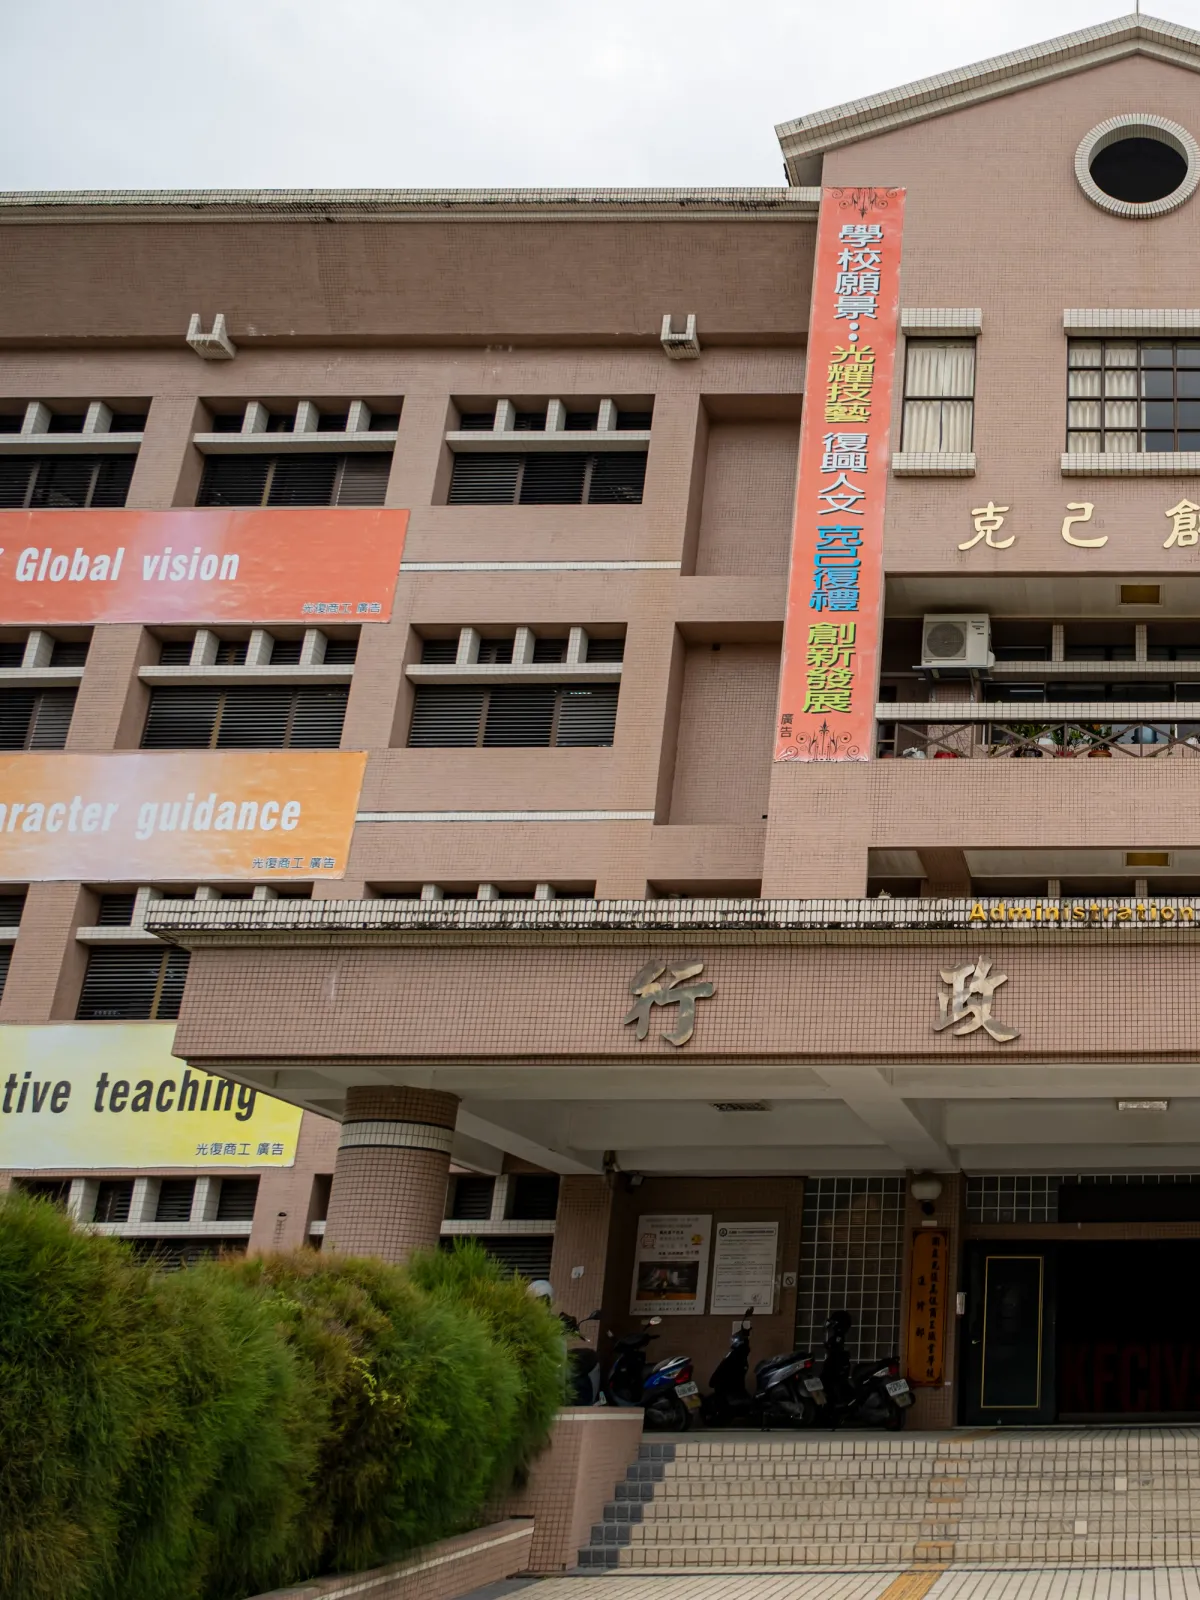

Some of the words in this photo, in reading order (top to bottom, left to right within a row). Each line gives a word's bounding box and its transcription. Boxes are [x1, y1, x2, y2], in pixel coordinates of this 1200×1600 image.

[817, 432, 870, 515] 復興人文
[15, 547, 125, 582] Global
[142, 547, 240, 581] vision
[809, 524, 863, 612] 克己復禮
[802, 622, 857, 713] 創新發展
[780, 713, 793, 738] 廣告
[135, 793, 301, 841] guidance
[253, 857, 304, 869] 光復商工
[310, 857, 335, 869] 廣告
[969, 901, 1194, 921] Administration
[94, 1070, 257, 1122] teaching
[195, 1142, 251, 1156] 光復商工
[256, 1142, 284, 1156] 廣告
